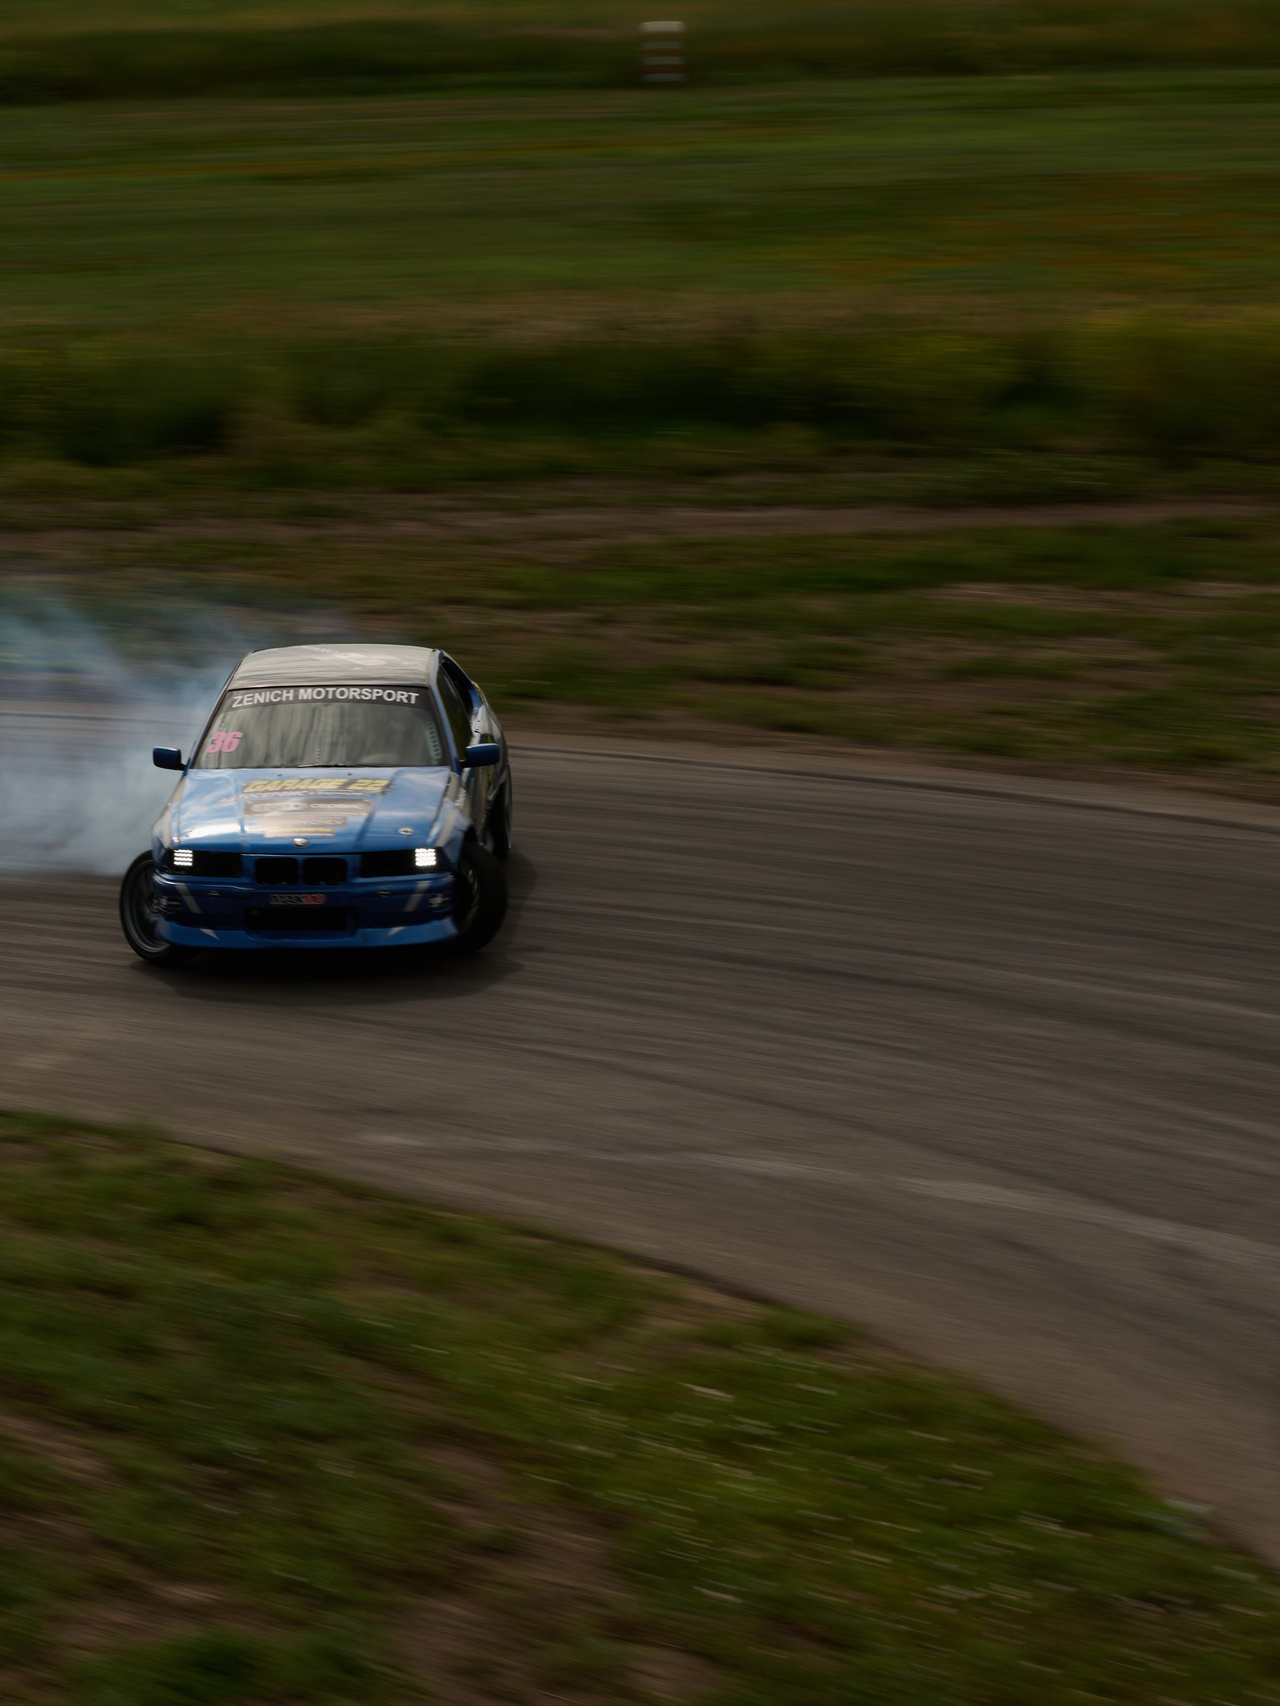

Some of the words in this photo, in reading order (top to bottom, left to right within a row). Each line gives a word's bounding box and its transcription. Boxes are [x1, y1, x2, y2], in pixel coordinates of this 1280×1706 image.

[232, 689, 294, 708] ZENICH
[298, 687, 420, 704] MOTORSPORT
[206, 731, 243, 754] 36
[243, 778, 349, 793] GARAGE
[347, 779, 390, 791] 22
